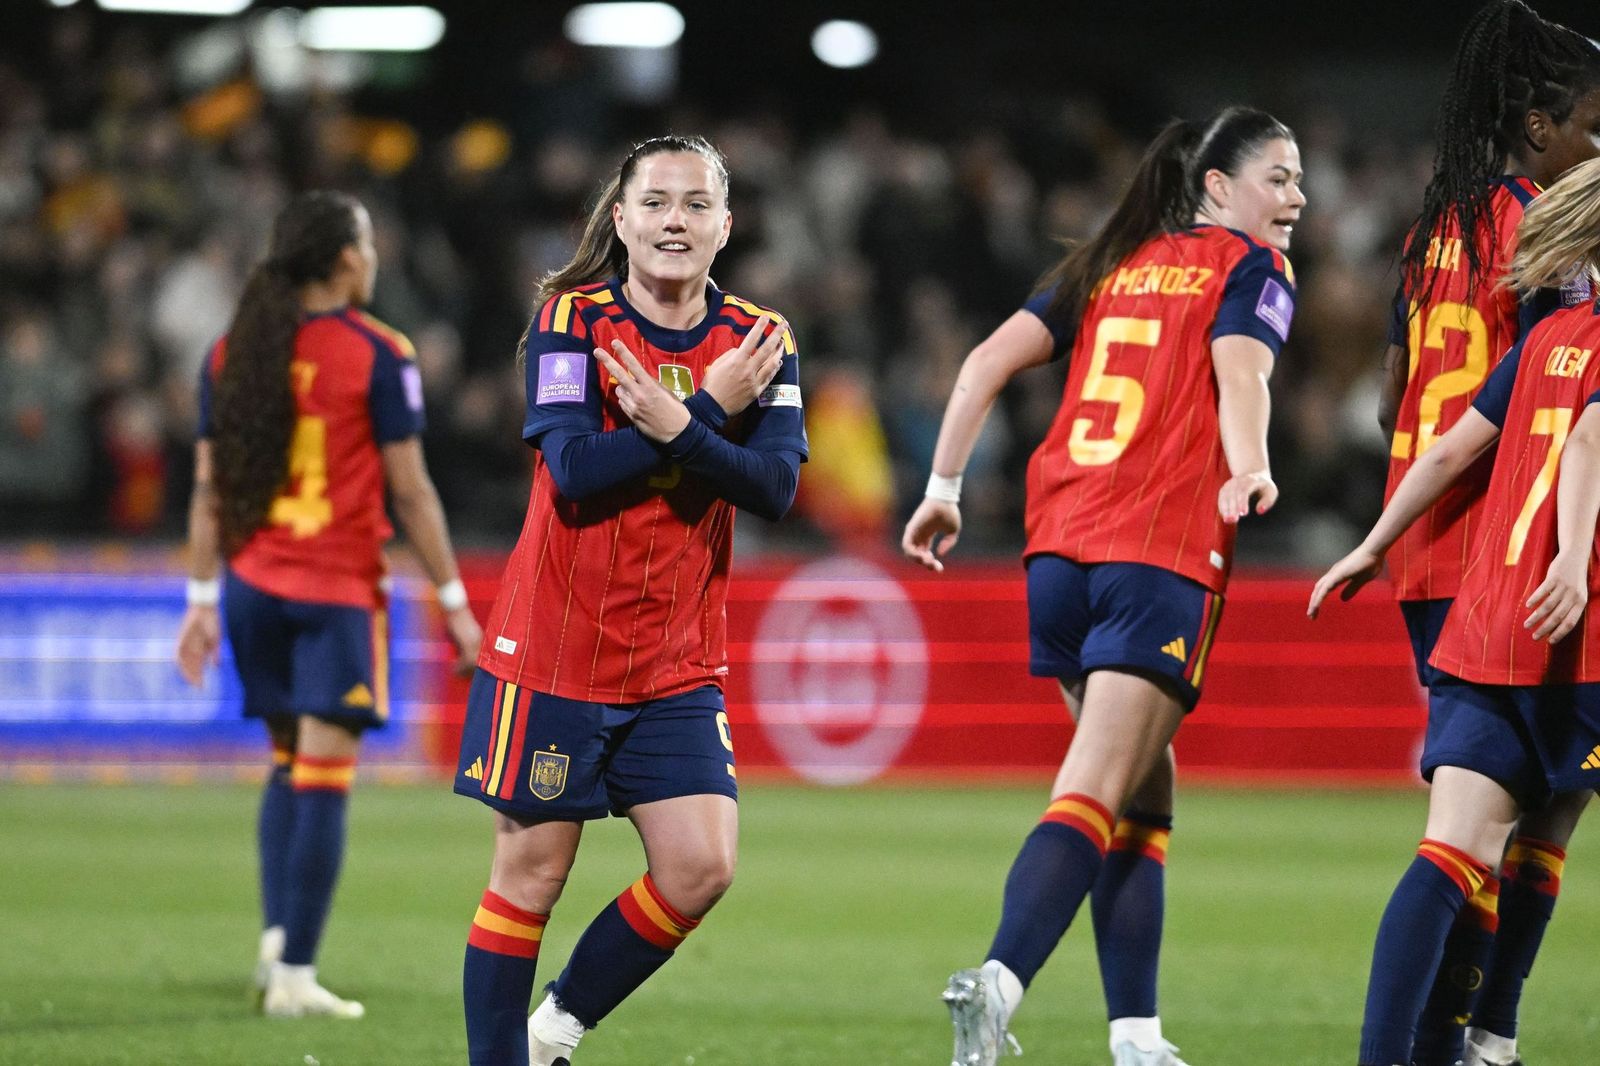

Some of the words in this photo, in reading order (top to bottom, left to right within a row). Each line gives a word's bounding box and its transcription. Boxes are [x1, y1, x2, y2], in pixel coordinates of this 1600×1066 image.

[1111, 259, 1214, 296] MÉNDEZ
[1544, 344, 1592, 378] OLGA
[541, 390, 580, 398] QUALIFIERS
[1068, 317, 1161, 466] 5
[1505, 407, 1574, 566] 7
